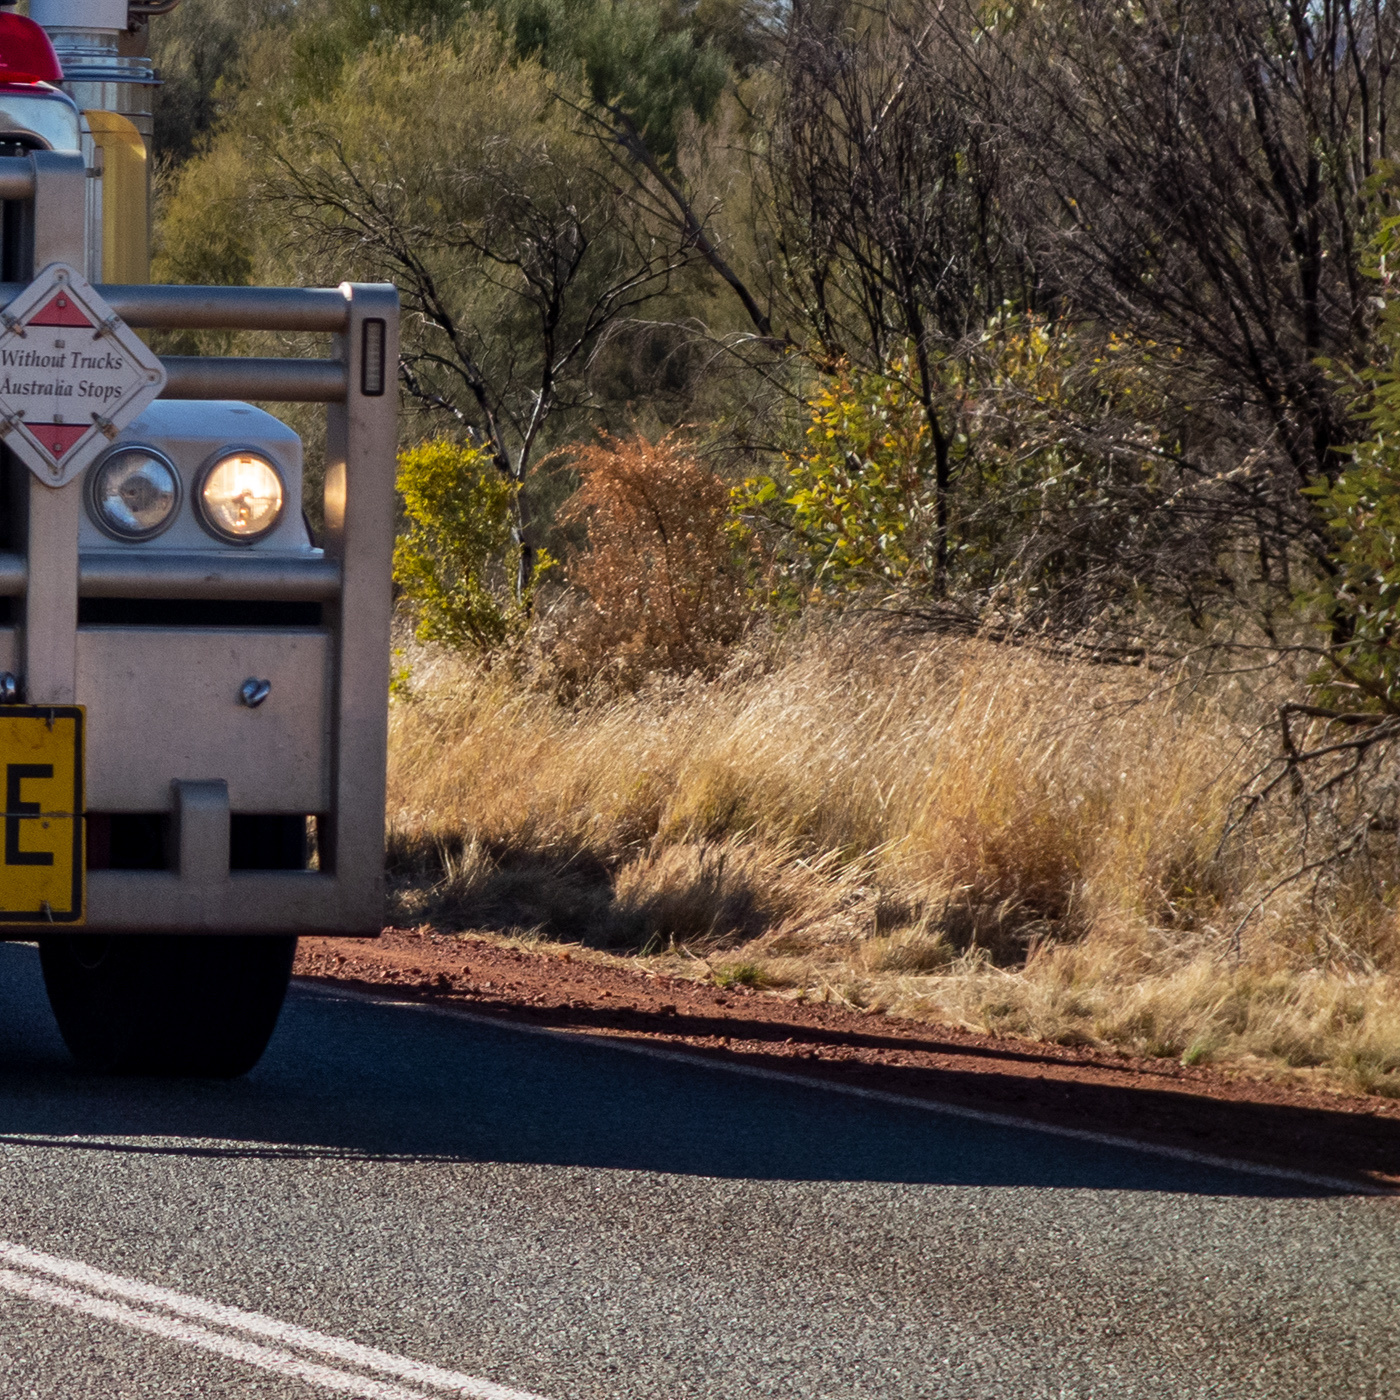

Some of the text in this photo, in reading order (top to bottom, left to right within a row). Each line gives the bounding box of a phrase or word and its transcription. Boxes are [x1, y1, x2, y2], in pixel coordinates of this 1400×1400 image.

[1, 349, 123, 370] Without Trucks
[77, 379, 123, 403] Stops
